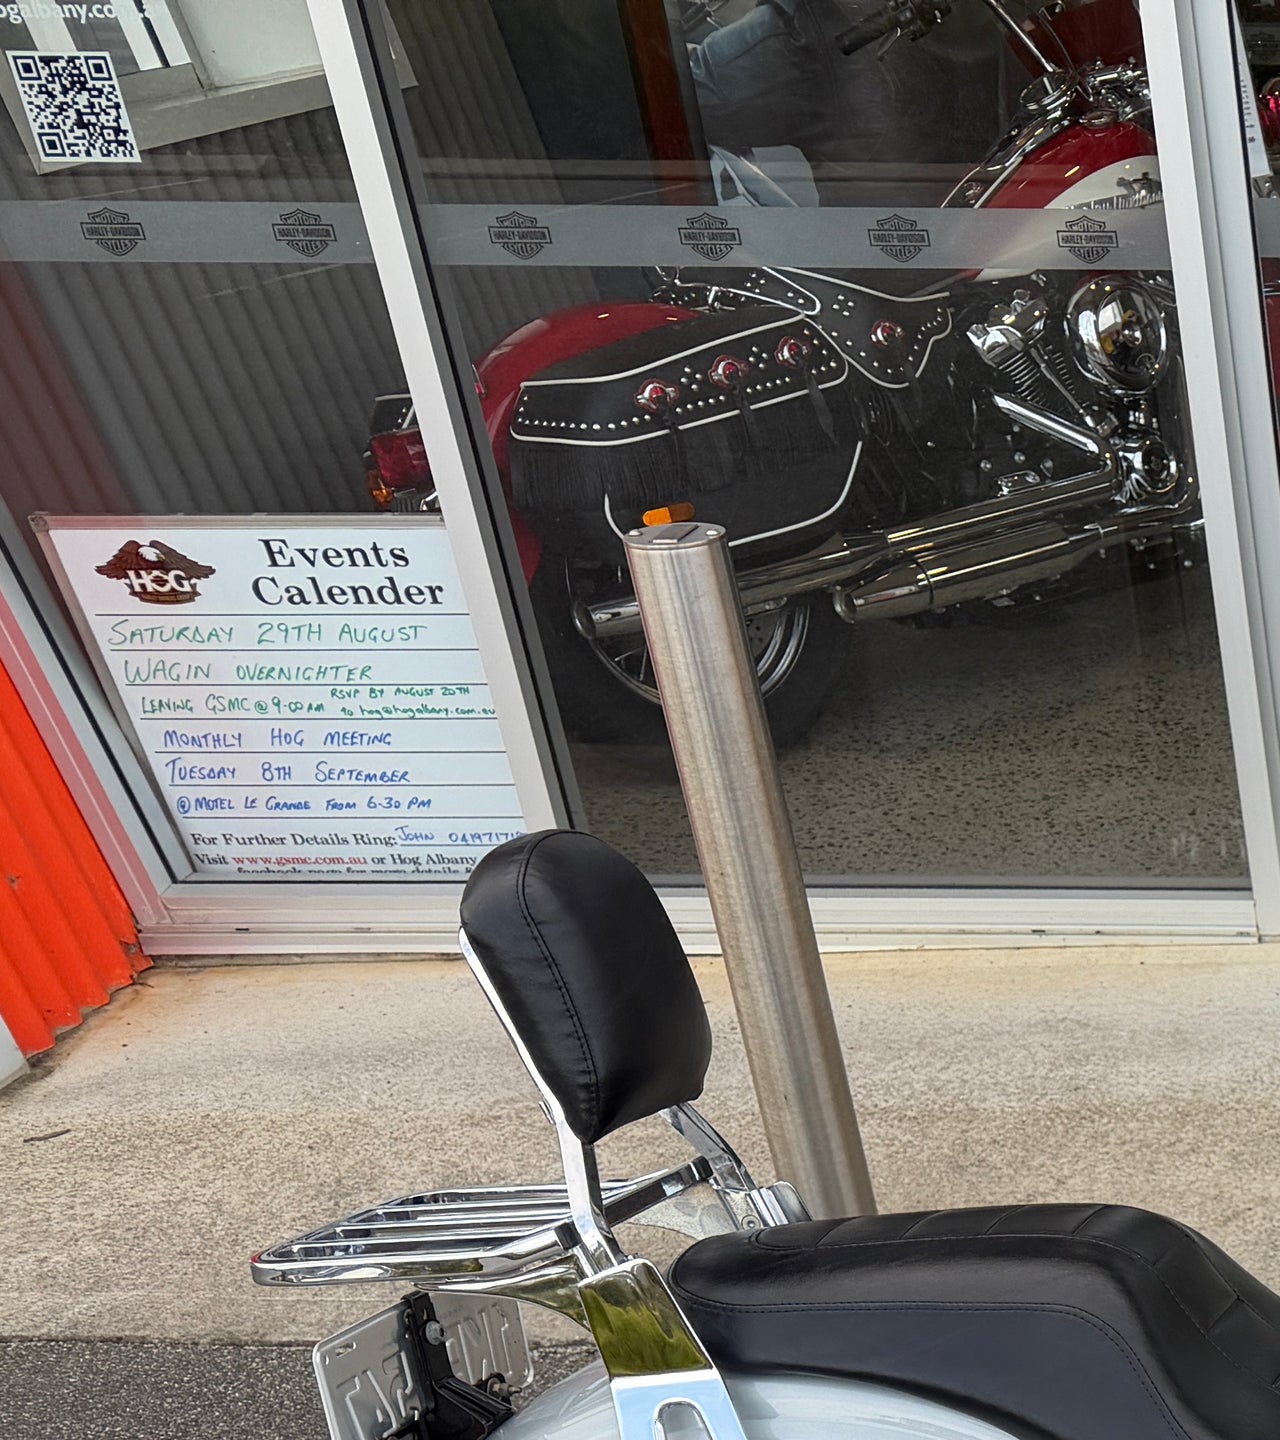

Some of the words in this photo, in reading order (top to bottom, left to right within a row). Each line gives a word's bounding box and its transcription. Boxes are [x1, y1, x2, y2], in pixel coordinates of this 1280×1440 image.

[258, 539, 410, 568] Events
[126, 570, 192, 592] HOG
[252, 576, 444, 605] Calender
[108, 619, 233, 645] SATURDAY
[257, 622, 322, 645] 29TH
[339, 623, 428, 643] AUGUST
[125, 658, 211, 683] WAGIN
[236, 663, 372, 682] OVERNIGHTER
[142, 697, 194, 713] LEAVING
[205, 693, 250, 713] GSMC
[330, 688, 360, 699] RSVP
[369, 687, 384, 699] BY
[394, 687, 434, 697] AUGUST
[164, 730, 242, 748] MONTHLY
[323, 731, 392, 746] MEETING
[165, 757, 236, 783] TUESDAY
[261, 761, 292, 782] 8TH
[315, 761, 410, 783] SEPTEMBER
[194, 797, 234, 811] MOTEL
[244, 796, 257, 809] LE
[266, 796, 311, 811] GRANDE
[407, 797, 432, 809] PM
[190, 833, 218, 846] For
[221, 833, 286, 846] Further
[290, 833, 349, 846] Details
[352, 833, 398, 847] Ring:
[193, 854, 229, 866] Visit
[231, 855, 368, 867] www.gsmc.com.au
[372, 856, 387, 866] or
[391, 854, 422, 867] Hog
[426, 854, 477, 867] Albany
